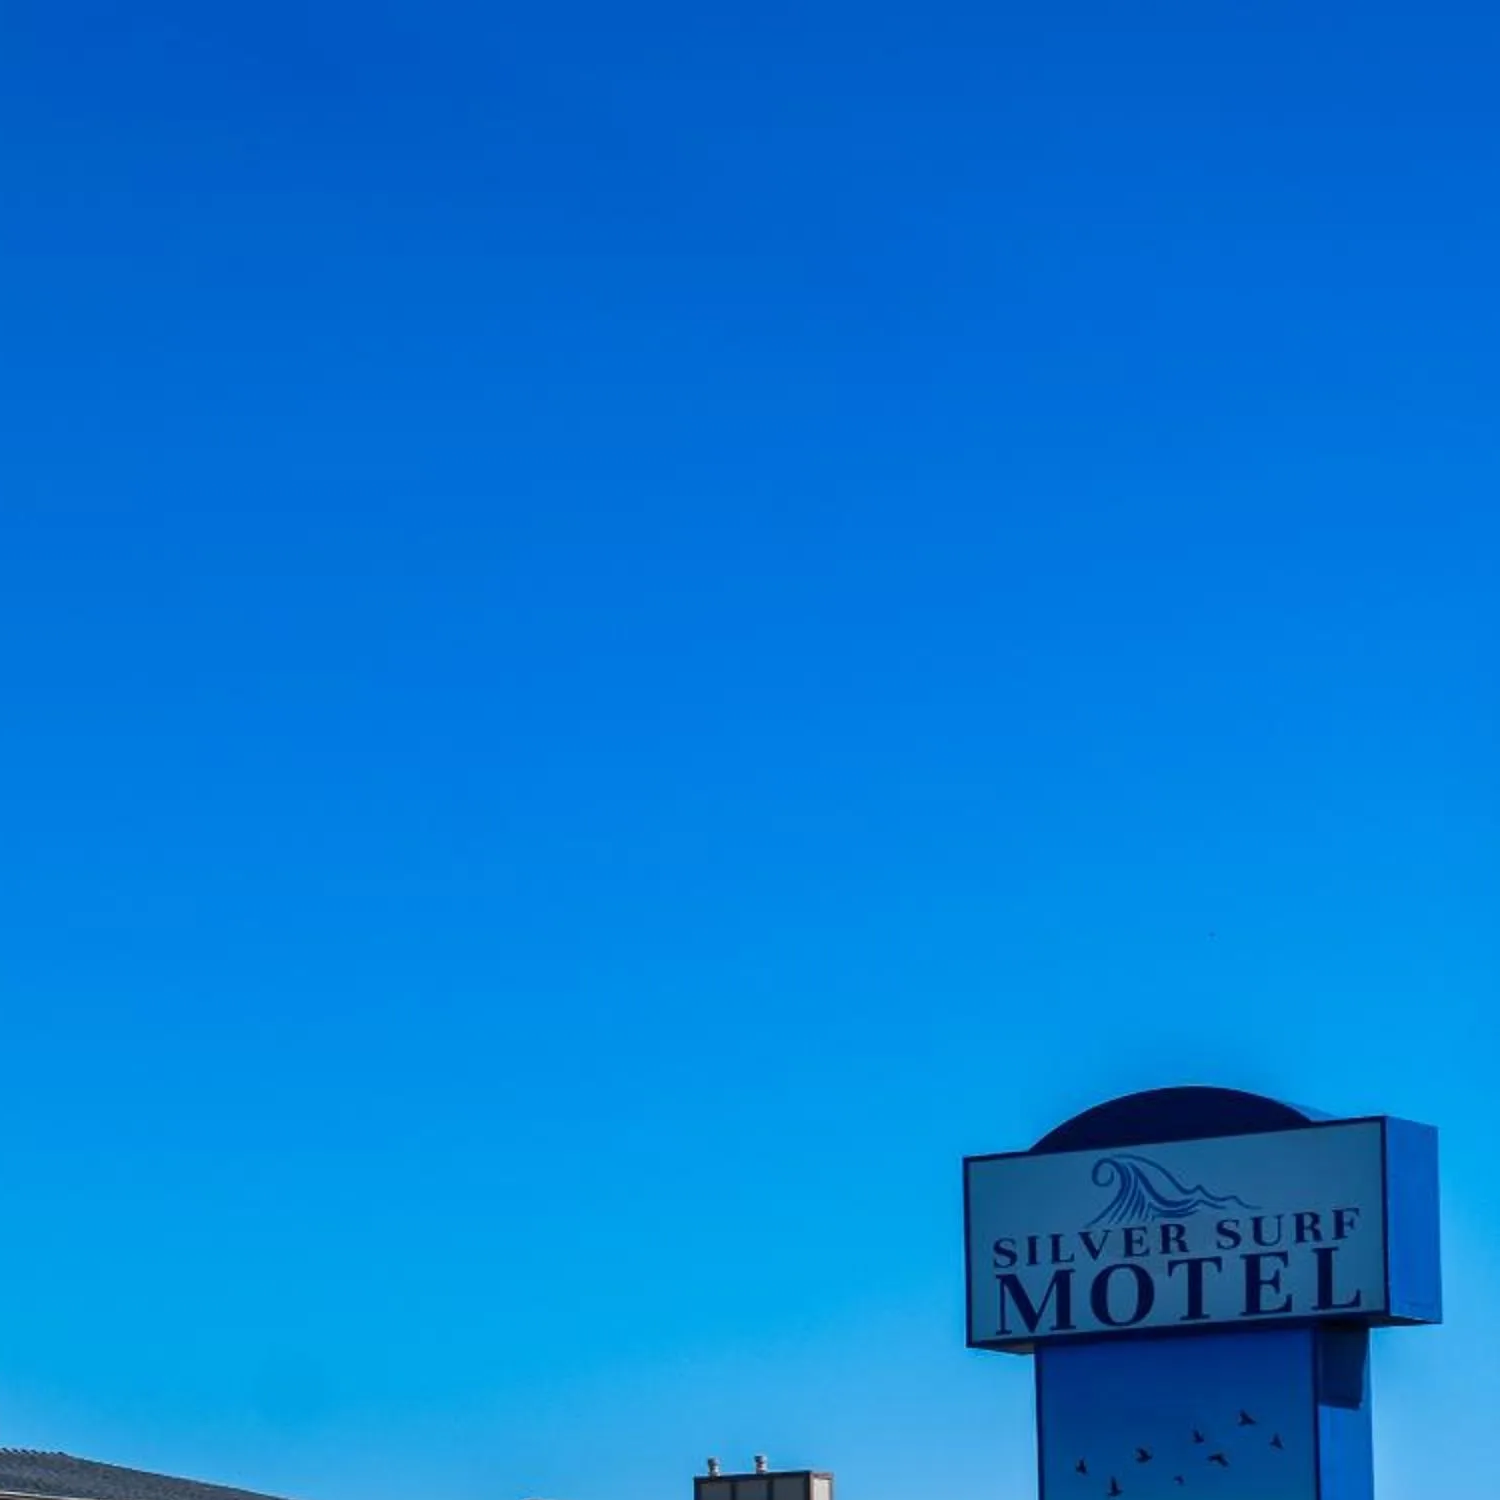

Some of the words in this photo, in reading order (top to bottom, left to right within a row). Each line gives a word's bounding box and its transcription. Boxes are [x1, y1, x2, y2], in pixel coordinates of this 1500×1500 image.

[993, 1222, 1190, 1269] SILVER
[1215, 1206, 1361, 1250] SURF
[994, 1246, 1362, 1336] MOTEL
